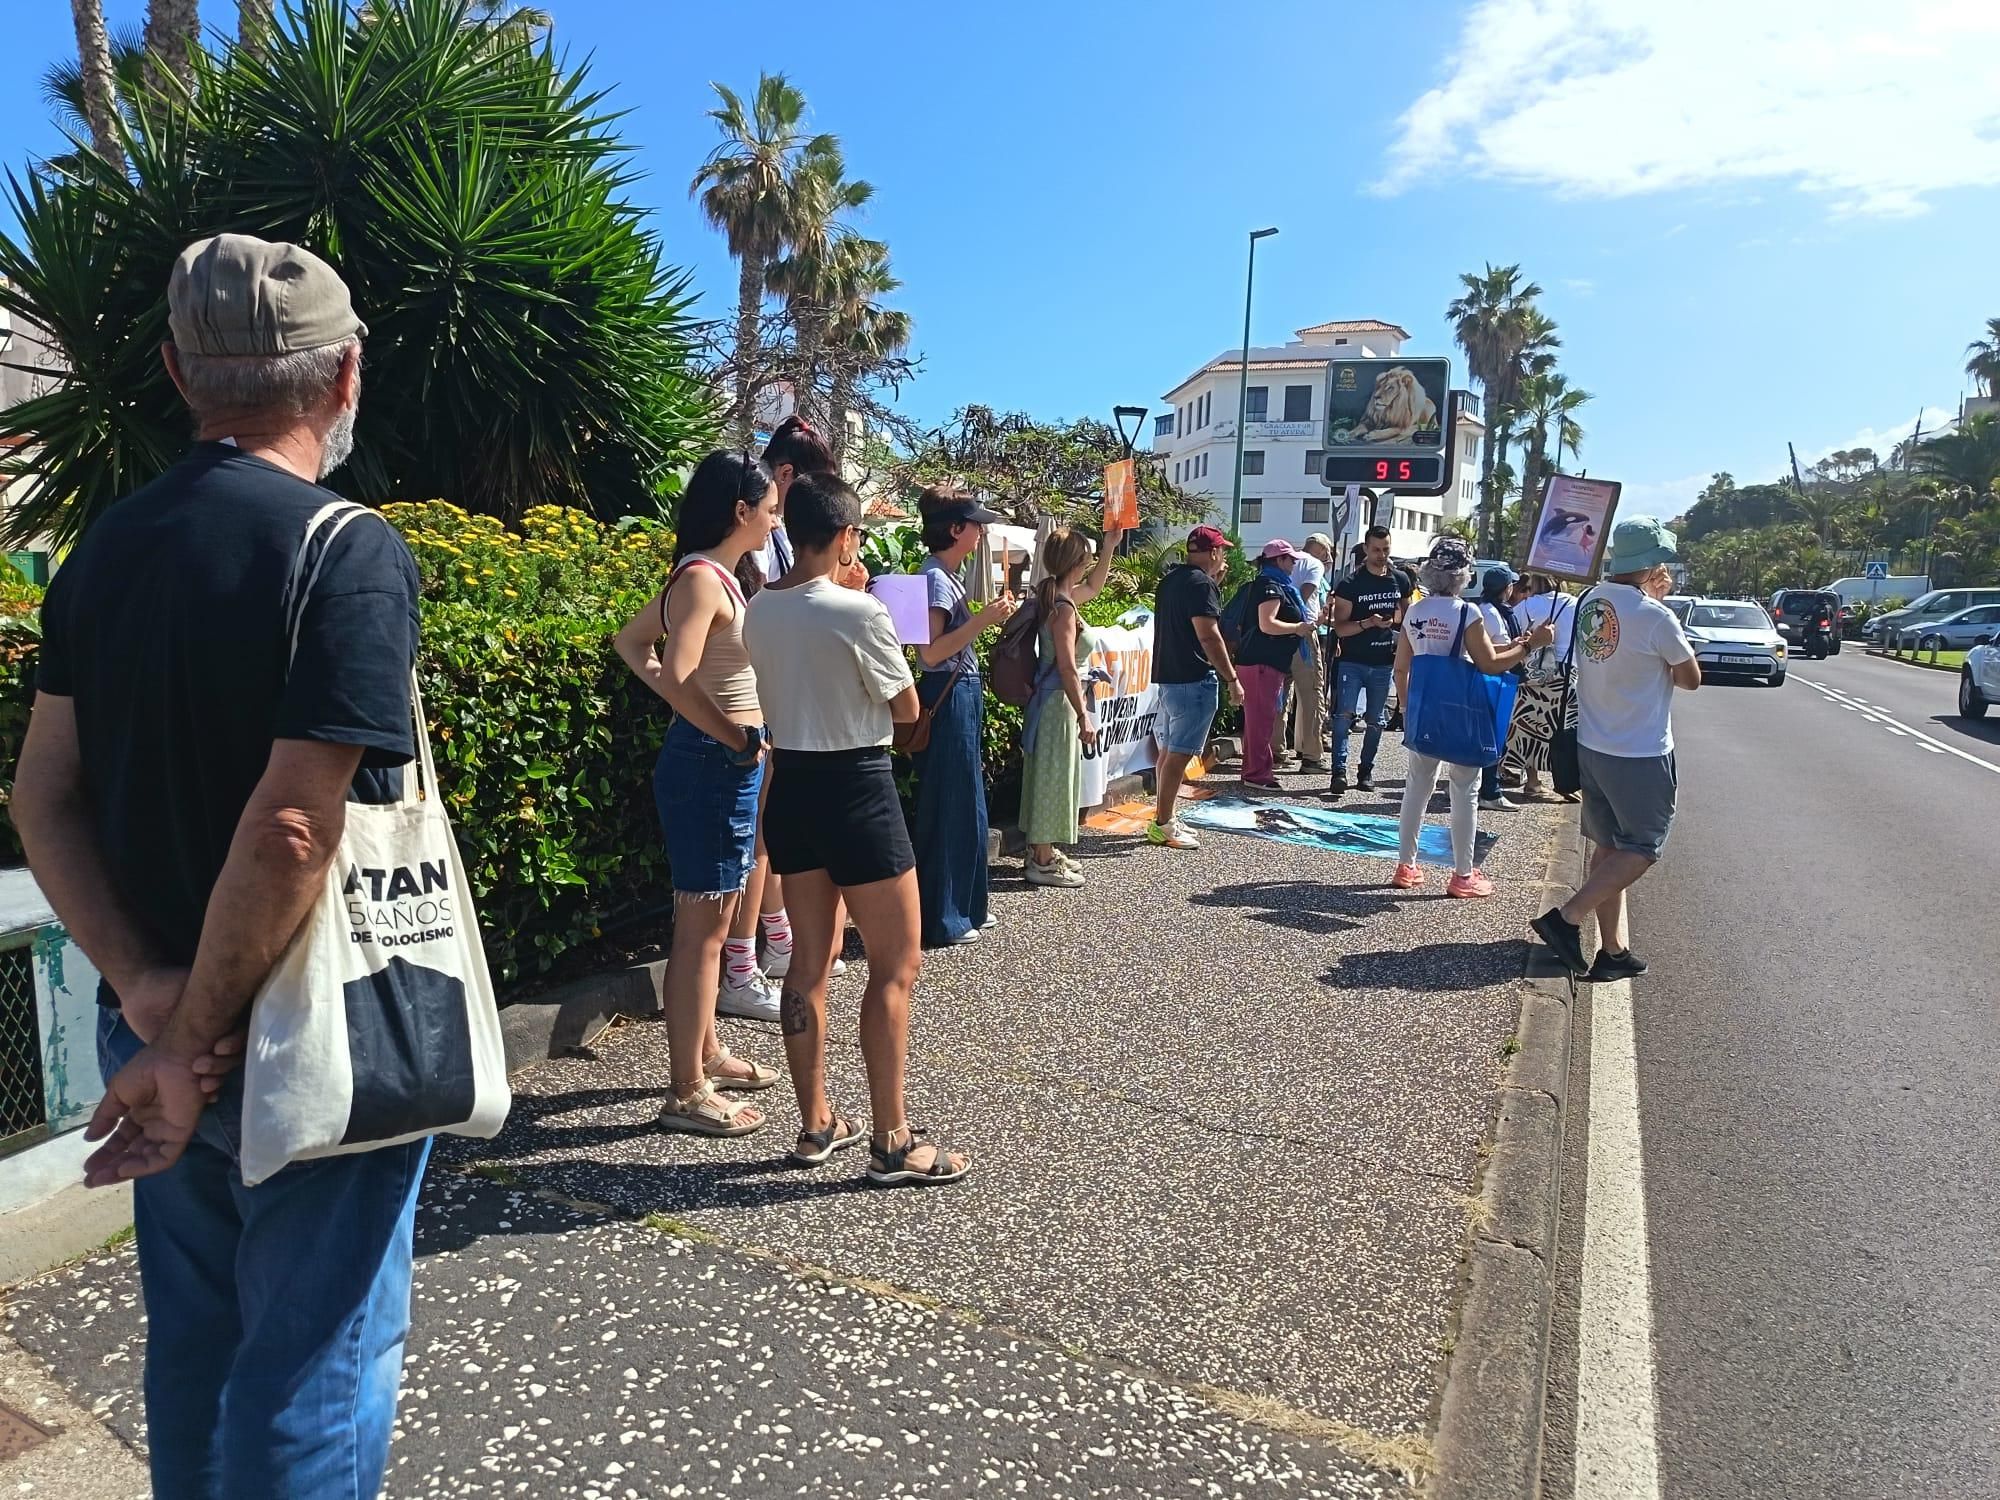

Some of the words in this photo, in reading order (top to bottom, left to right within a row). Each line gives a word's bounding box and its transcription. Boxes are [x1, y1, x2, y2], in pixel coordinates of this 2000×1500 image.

[1428, 618, 1438, 627] NO
[343, 859, 448, 902] ATAN
[376, 898, 452, 929] AÑOS
[351, 931, 373, 943] DE
